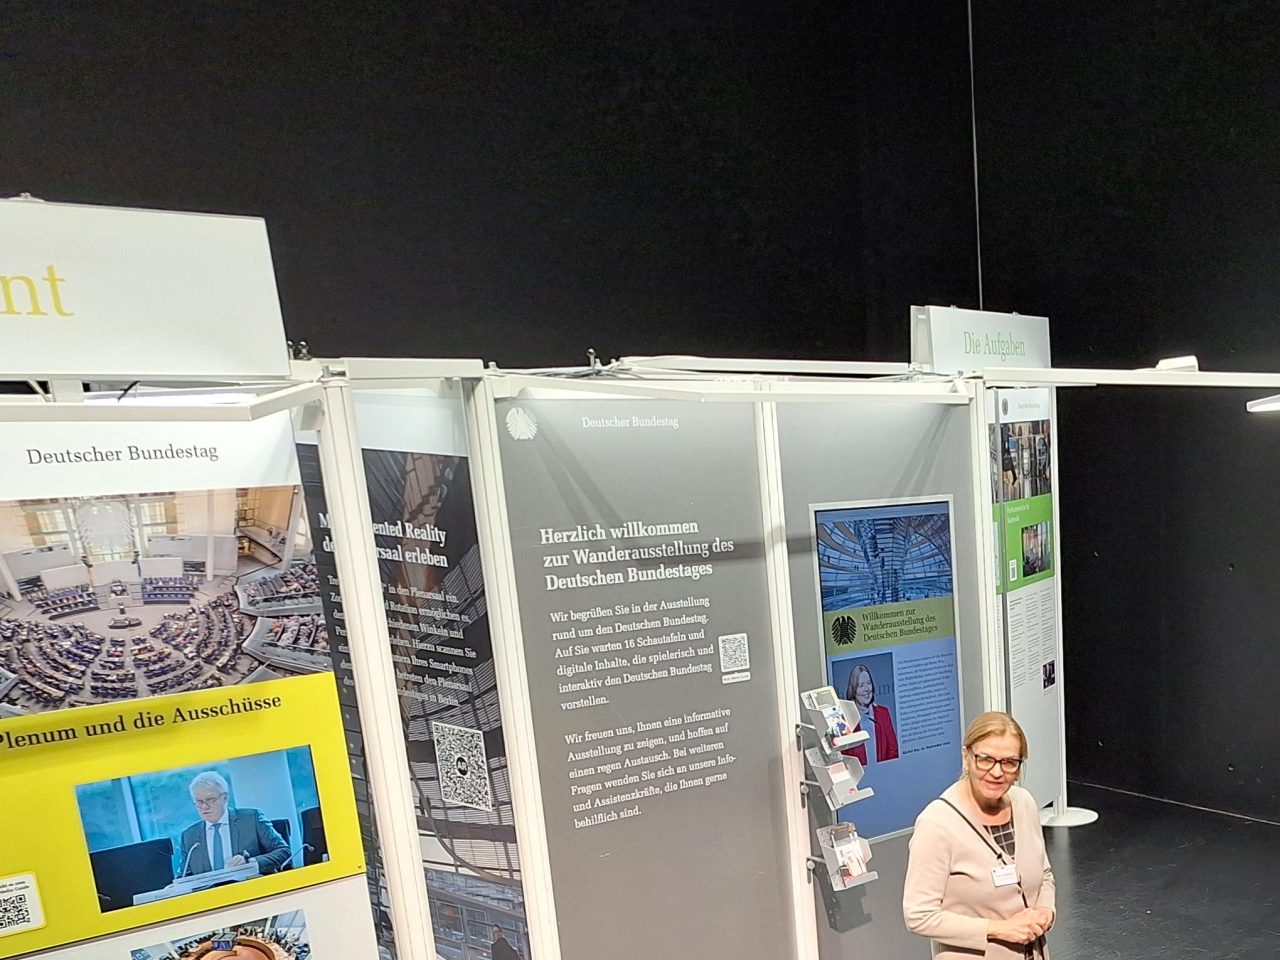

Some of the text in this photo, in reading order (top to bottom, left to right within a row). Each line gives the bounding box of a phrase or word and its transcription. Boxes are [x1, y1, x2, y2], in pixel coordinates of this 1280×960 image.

[964, 332, 1025, 362] Die Aufgaben
[582, 416, 679, 429] Deutscher Bundestag
[26, 443, 218, 464] Deutscher Bundestag
[404, 522, 446, 547] Reality
[540, 522, 698, 544] Herzlich willkommen
[405, 547, 448, 567] erleben
[543, 538, 734, 567] zur Wanderausstellung des
[545, 564, 712, 590] Deutschen Bundestages
[550, 597, 710, 622] Wir begrüßen Sie in der Ausstellung
[862, 611, 903, 621] Willkommen
[552, 614, 709, 640] rund um den Deutschen Bundestag.
[863, 618, 924, 631] Wanderausstellung
[864, 625, 938, 642] Deutschen Bundestages
[555, 629, 705, 658] Auf Sie warten 16 Schautafeln und
[557, 644, 714, 677] digitale Inhalte, die spielerisch und
[559, 663, 713, 693] interaktiv den Deutschen Bundestag
[561, 695, 609, 710] vorstellen.
[84, 715, 126, 736] und
[133, 712, 164, 729] die
[172, 697, 281, 723] Ausschüsse
[565, 708, 730, 744] Wir freuen uns, Ihnen eine informative
[567, 722, 728, 762] Ausstellung zu zeigen, und hoffen auf
[569, 742, 724, 778] einen regen Austausch. Bei weiteren
[571, 783, 602, 795] Fragen
[604, 774, 640, 788] wenden
[641, 770, 655, 781] Sie
[657, 765, 675, 777] sich
[689, 760, 716, 770] unsere
[717, 754, 736, 765] Info-
[573, 773, 727, 812] und Assistenzkräfte, die Ihnen gerne
[574, 805, 642, 828] behilflich sind.
